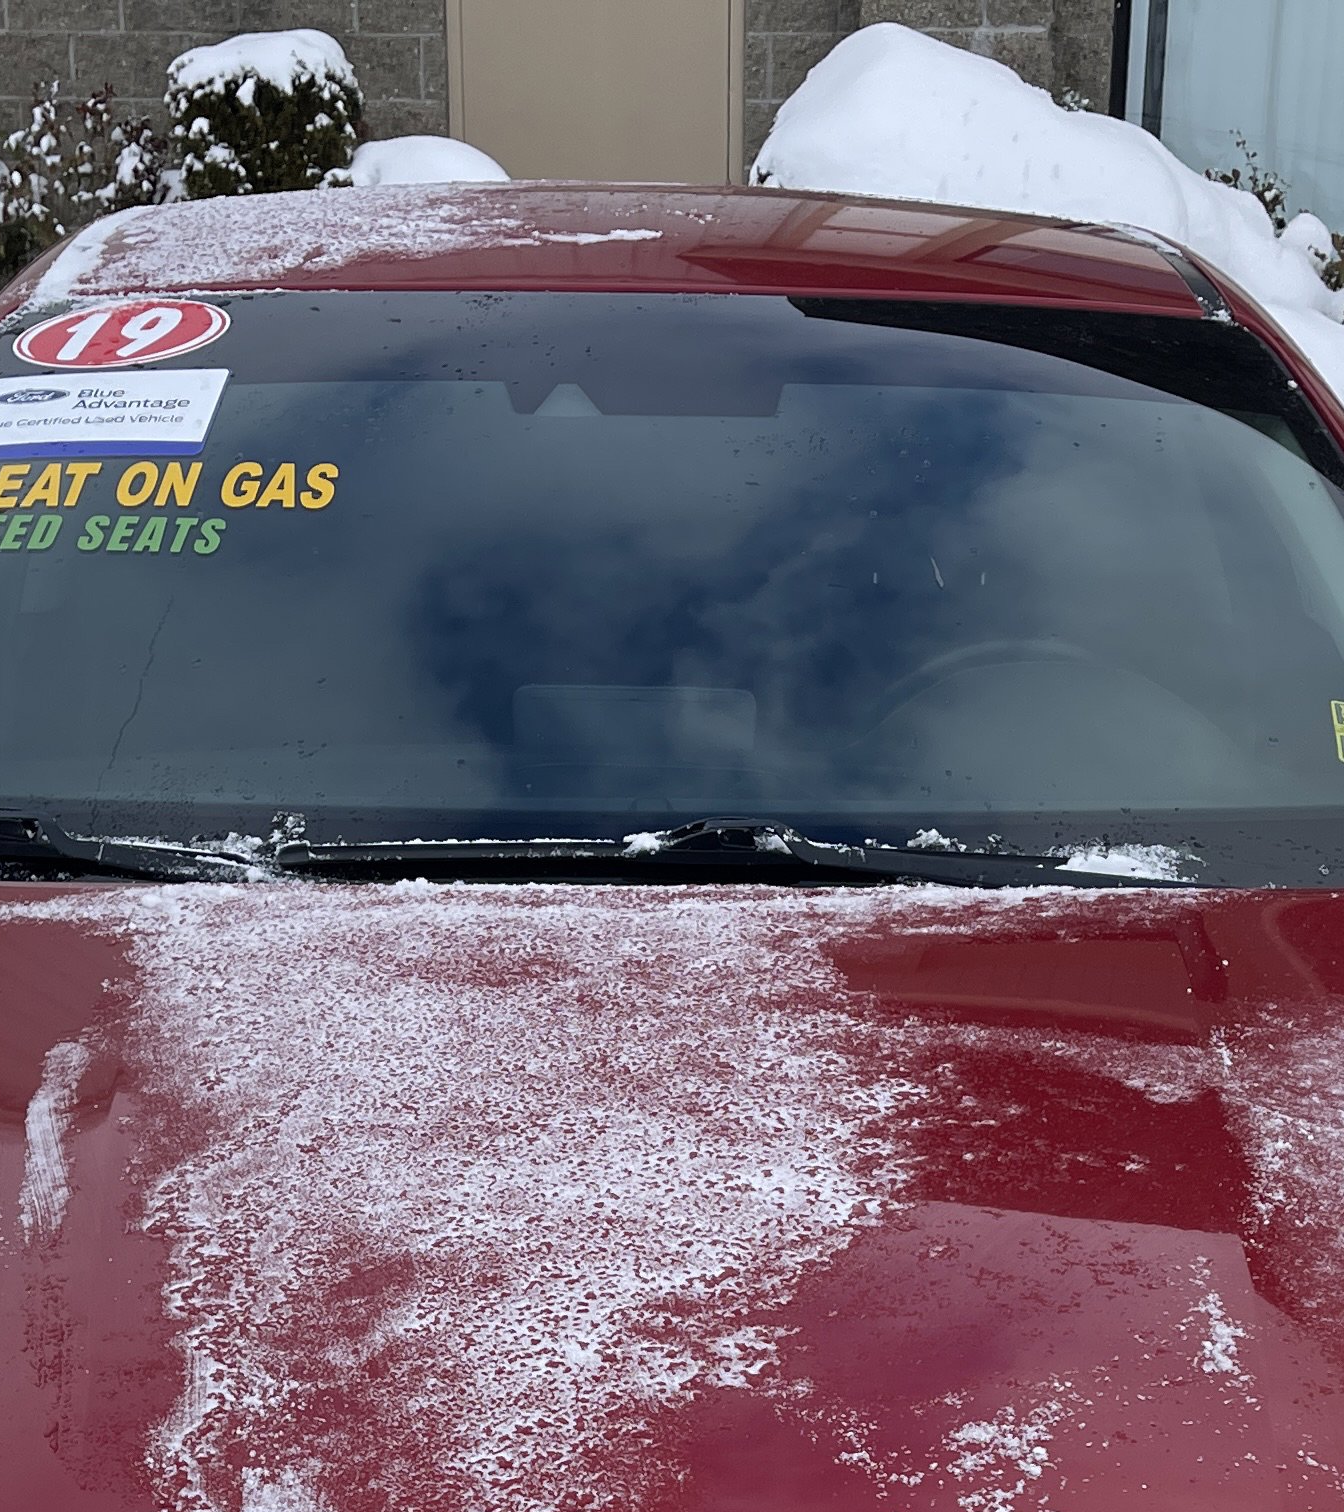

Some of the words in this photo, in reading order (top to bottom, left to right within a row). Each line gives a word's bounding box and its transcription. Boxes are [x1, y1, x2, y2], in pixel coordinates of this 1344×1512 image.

[56, 306, 183, 361] 19
[71, 398, 191, 410] Advantage
[77, 388, 126, 398] Blue
[16, 415, 82, 427] Certified
[85, 414, 126, 425] Used
[129, 413, 184, 424] Vehicle
[115, 460, 203, 508] ON
[219, 462, 340, 510] GAS
[76, 515, 228, 556] SEATS
